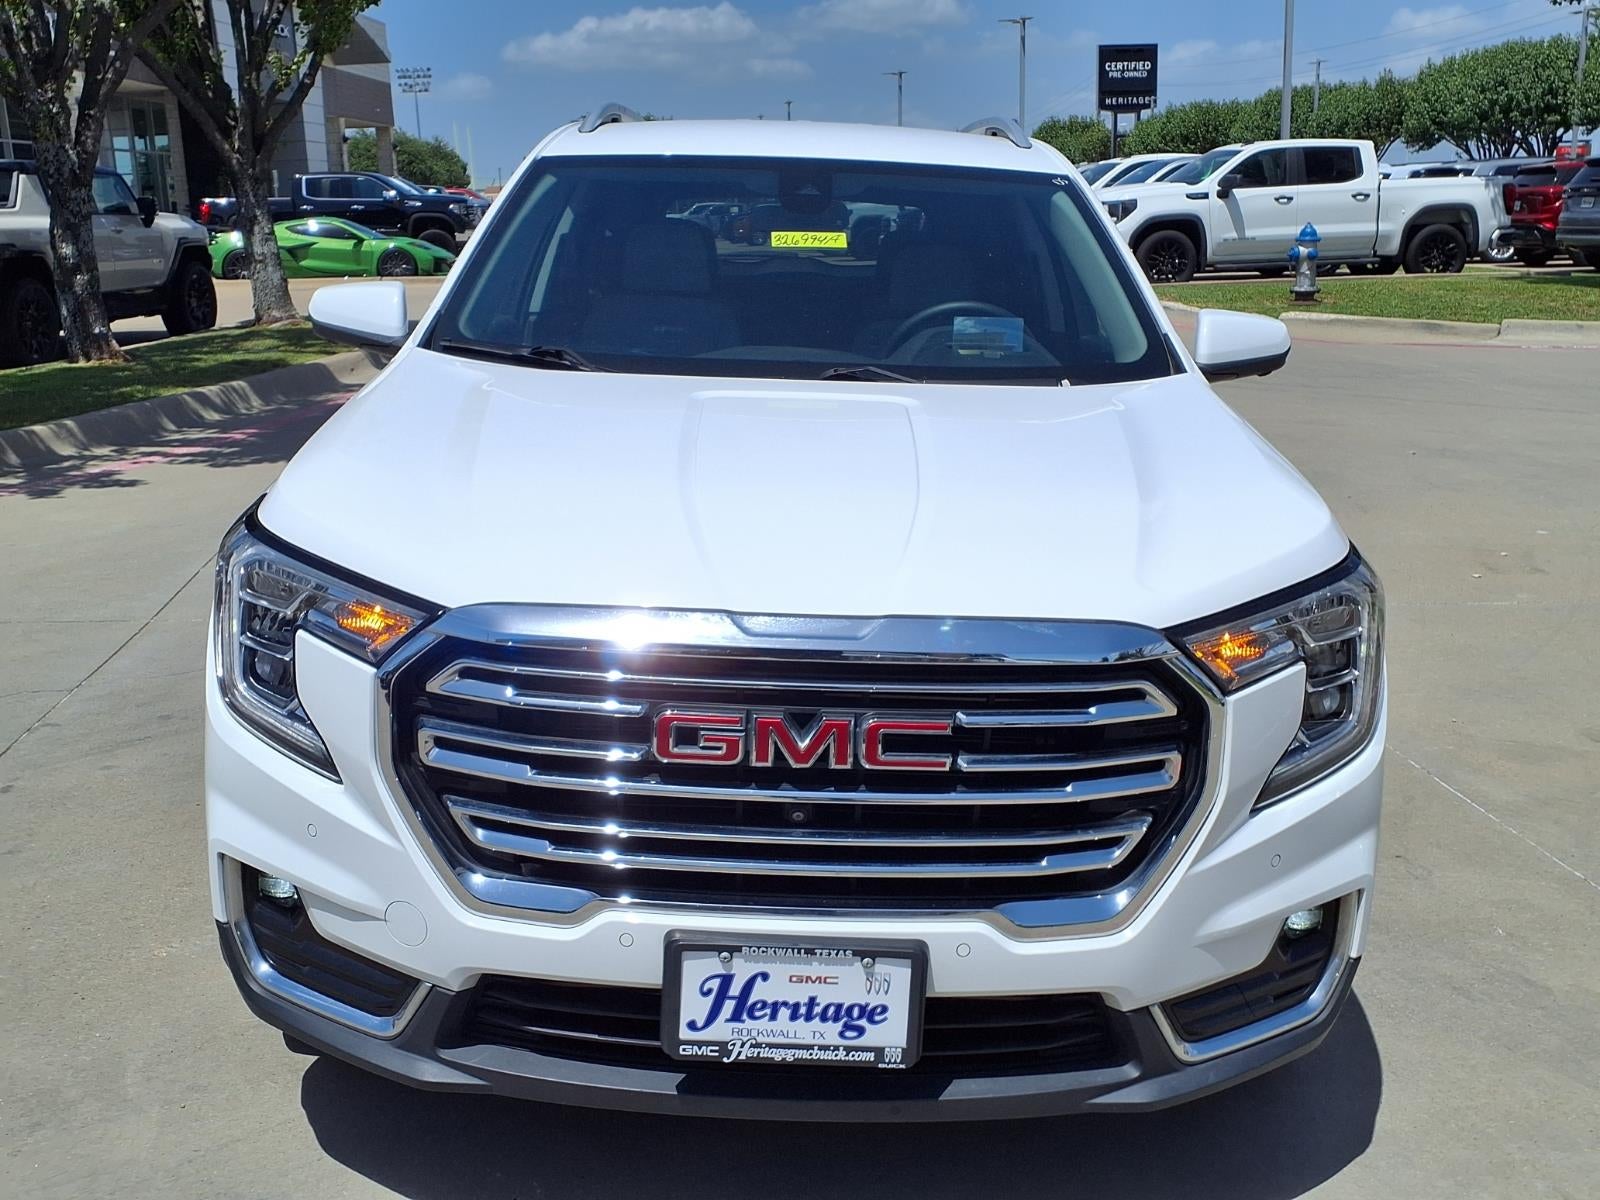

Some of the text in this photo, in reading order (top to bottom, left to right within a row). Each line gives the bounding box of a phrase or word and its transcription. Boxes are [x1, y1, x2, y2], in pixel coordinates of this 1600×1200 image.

[1105, 61, 1151, 71] CERTIFIED
[1105, 96, 1150, 105] HERITAGE
[652, 704, 952, 770] GMC
[741, 946, 853, 959] ROCKWALL, TEXAS
[788, 975, 840, 985] GMC
[686, 971, 889, 1041] Heritage
[810, 1030, 826, 1040] TX
[679, 1045, 720, 1056] GMC
[722, 1038, 875, 1063] Heritagegmcbuick.com
